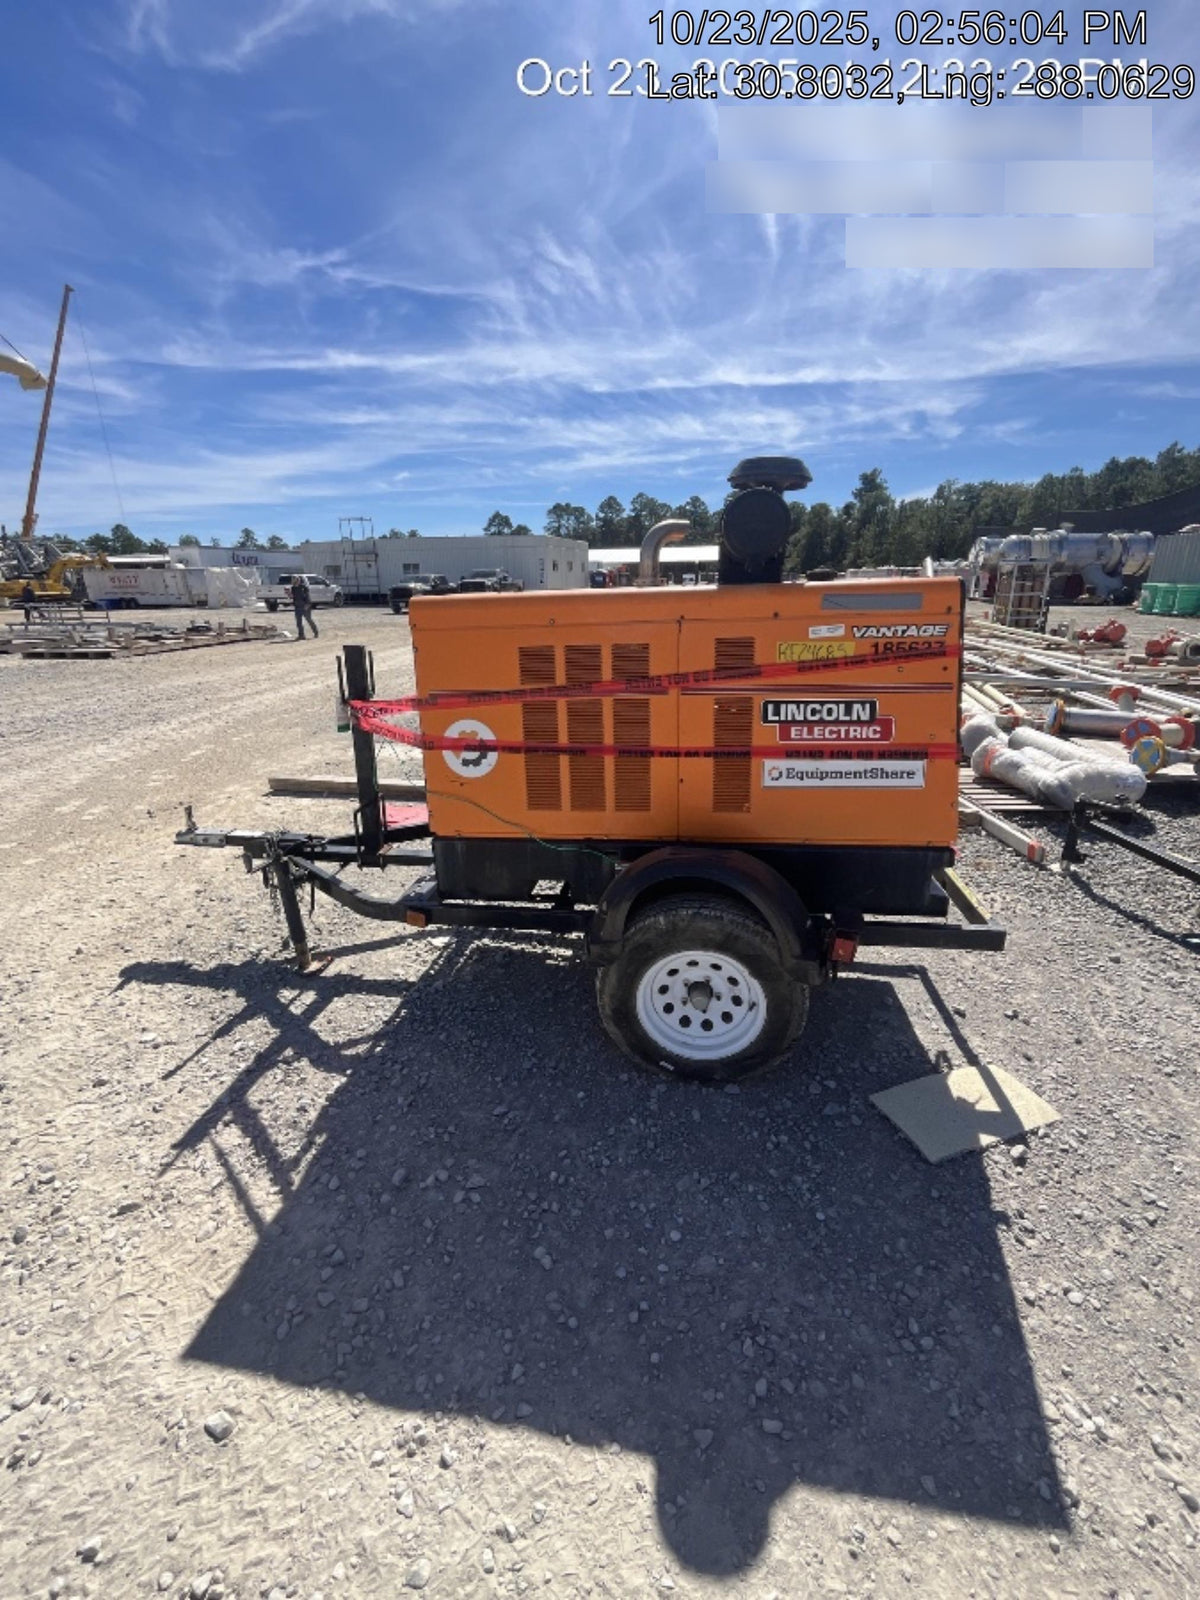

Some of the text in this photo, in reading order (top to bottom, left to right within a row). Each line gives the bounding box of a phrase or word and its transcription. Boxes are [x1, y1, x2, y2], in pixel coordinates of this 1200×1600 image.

[852, 624, 949, 638] VANTAGE
[767, 703, 871, 721] LINCOLN
[790, 726, 882, 739] ELECTRIC
[785, 767, 916, 781] EquipmentShare
